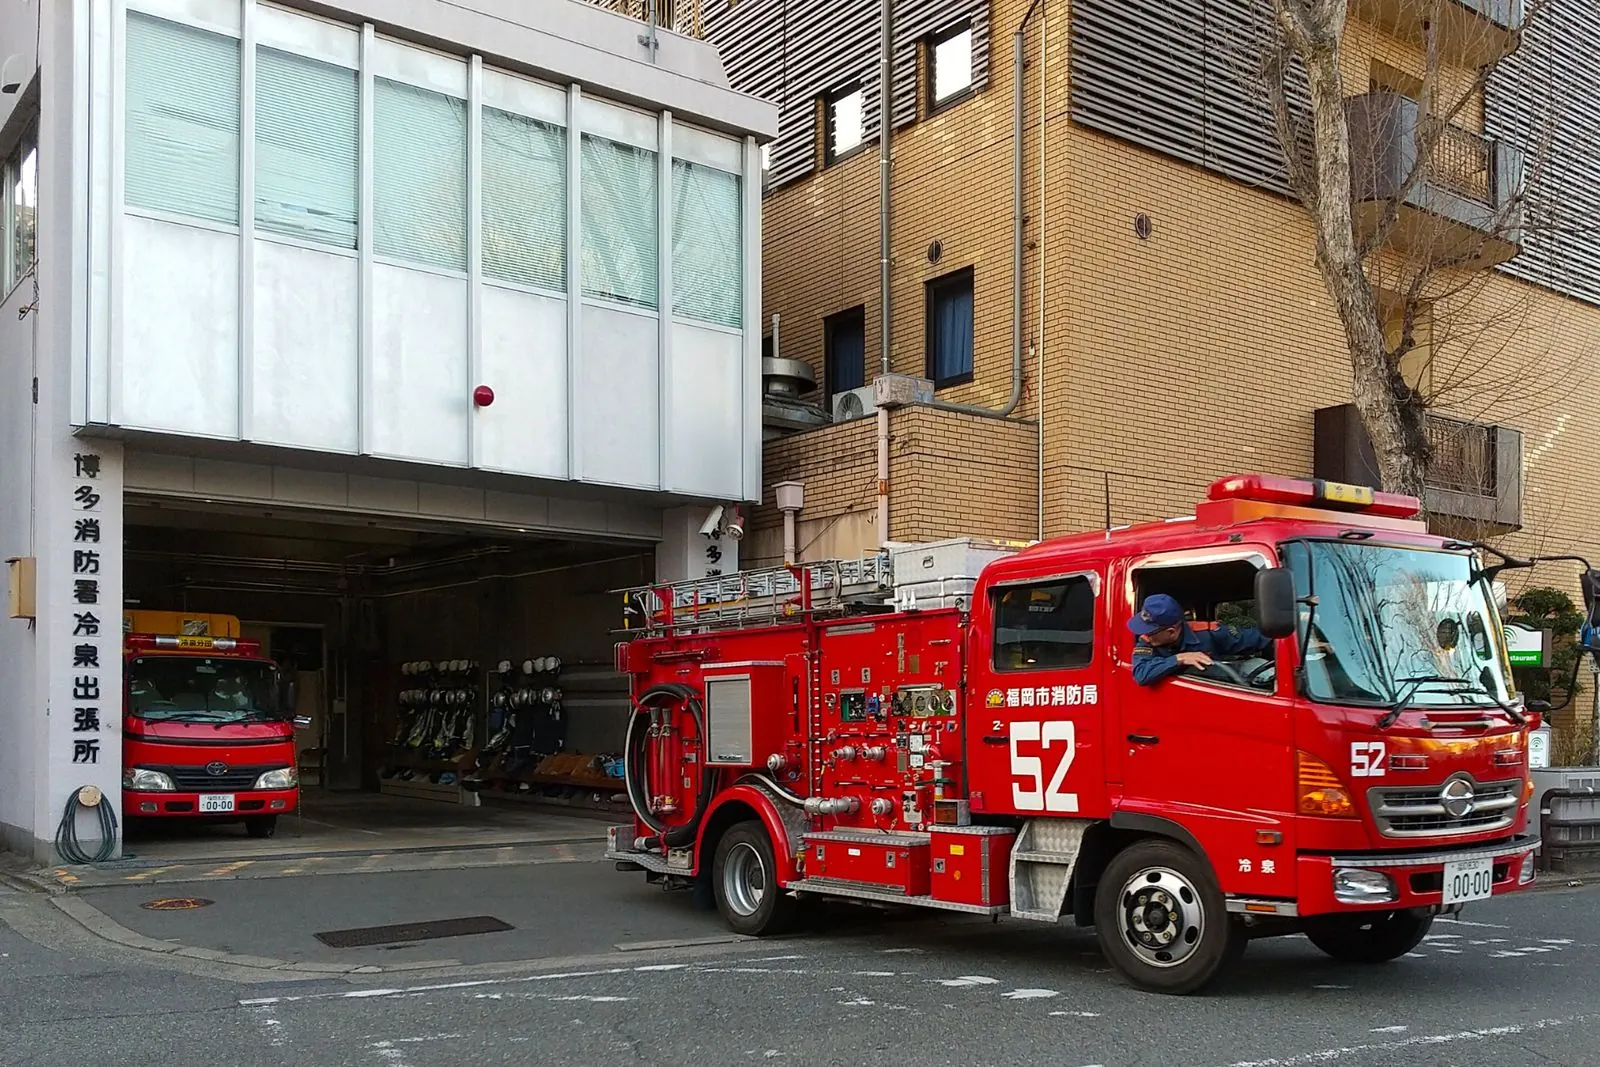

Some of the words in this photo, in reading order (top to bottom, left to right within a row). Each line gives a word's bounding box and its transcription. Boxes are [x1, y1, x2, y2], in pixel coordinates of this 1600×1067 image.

[73, 452, 101, 764] 博多消防署冷泉出張所
[1006, 684, 1098, 708] 福岡市消防局
[1009, 720, 1079, 813] 52
[1350, 741, 1386, 777] 52
